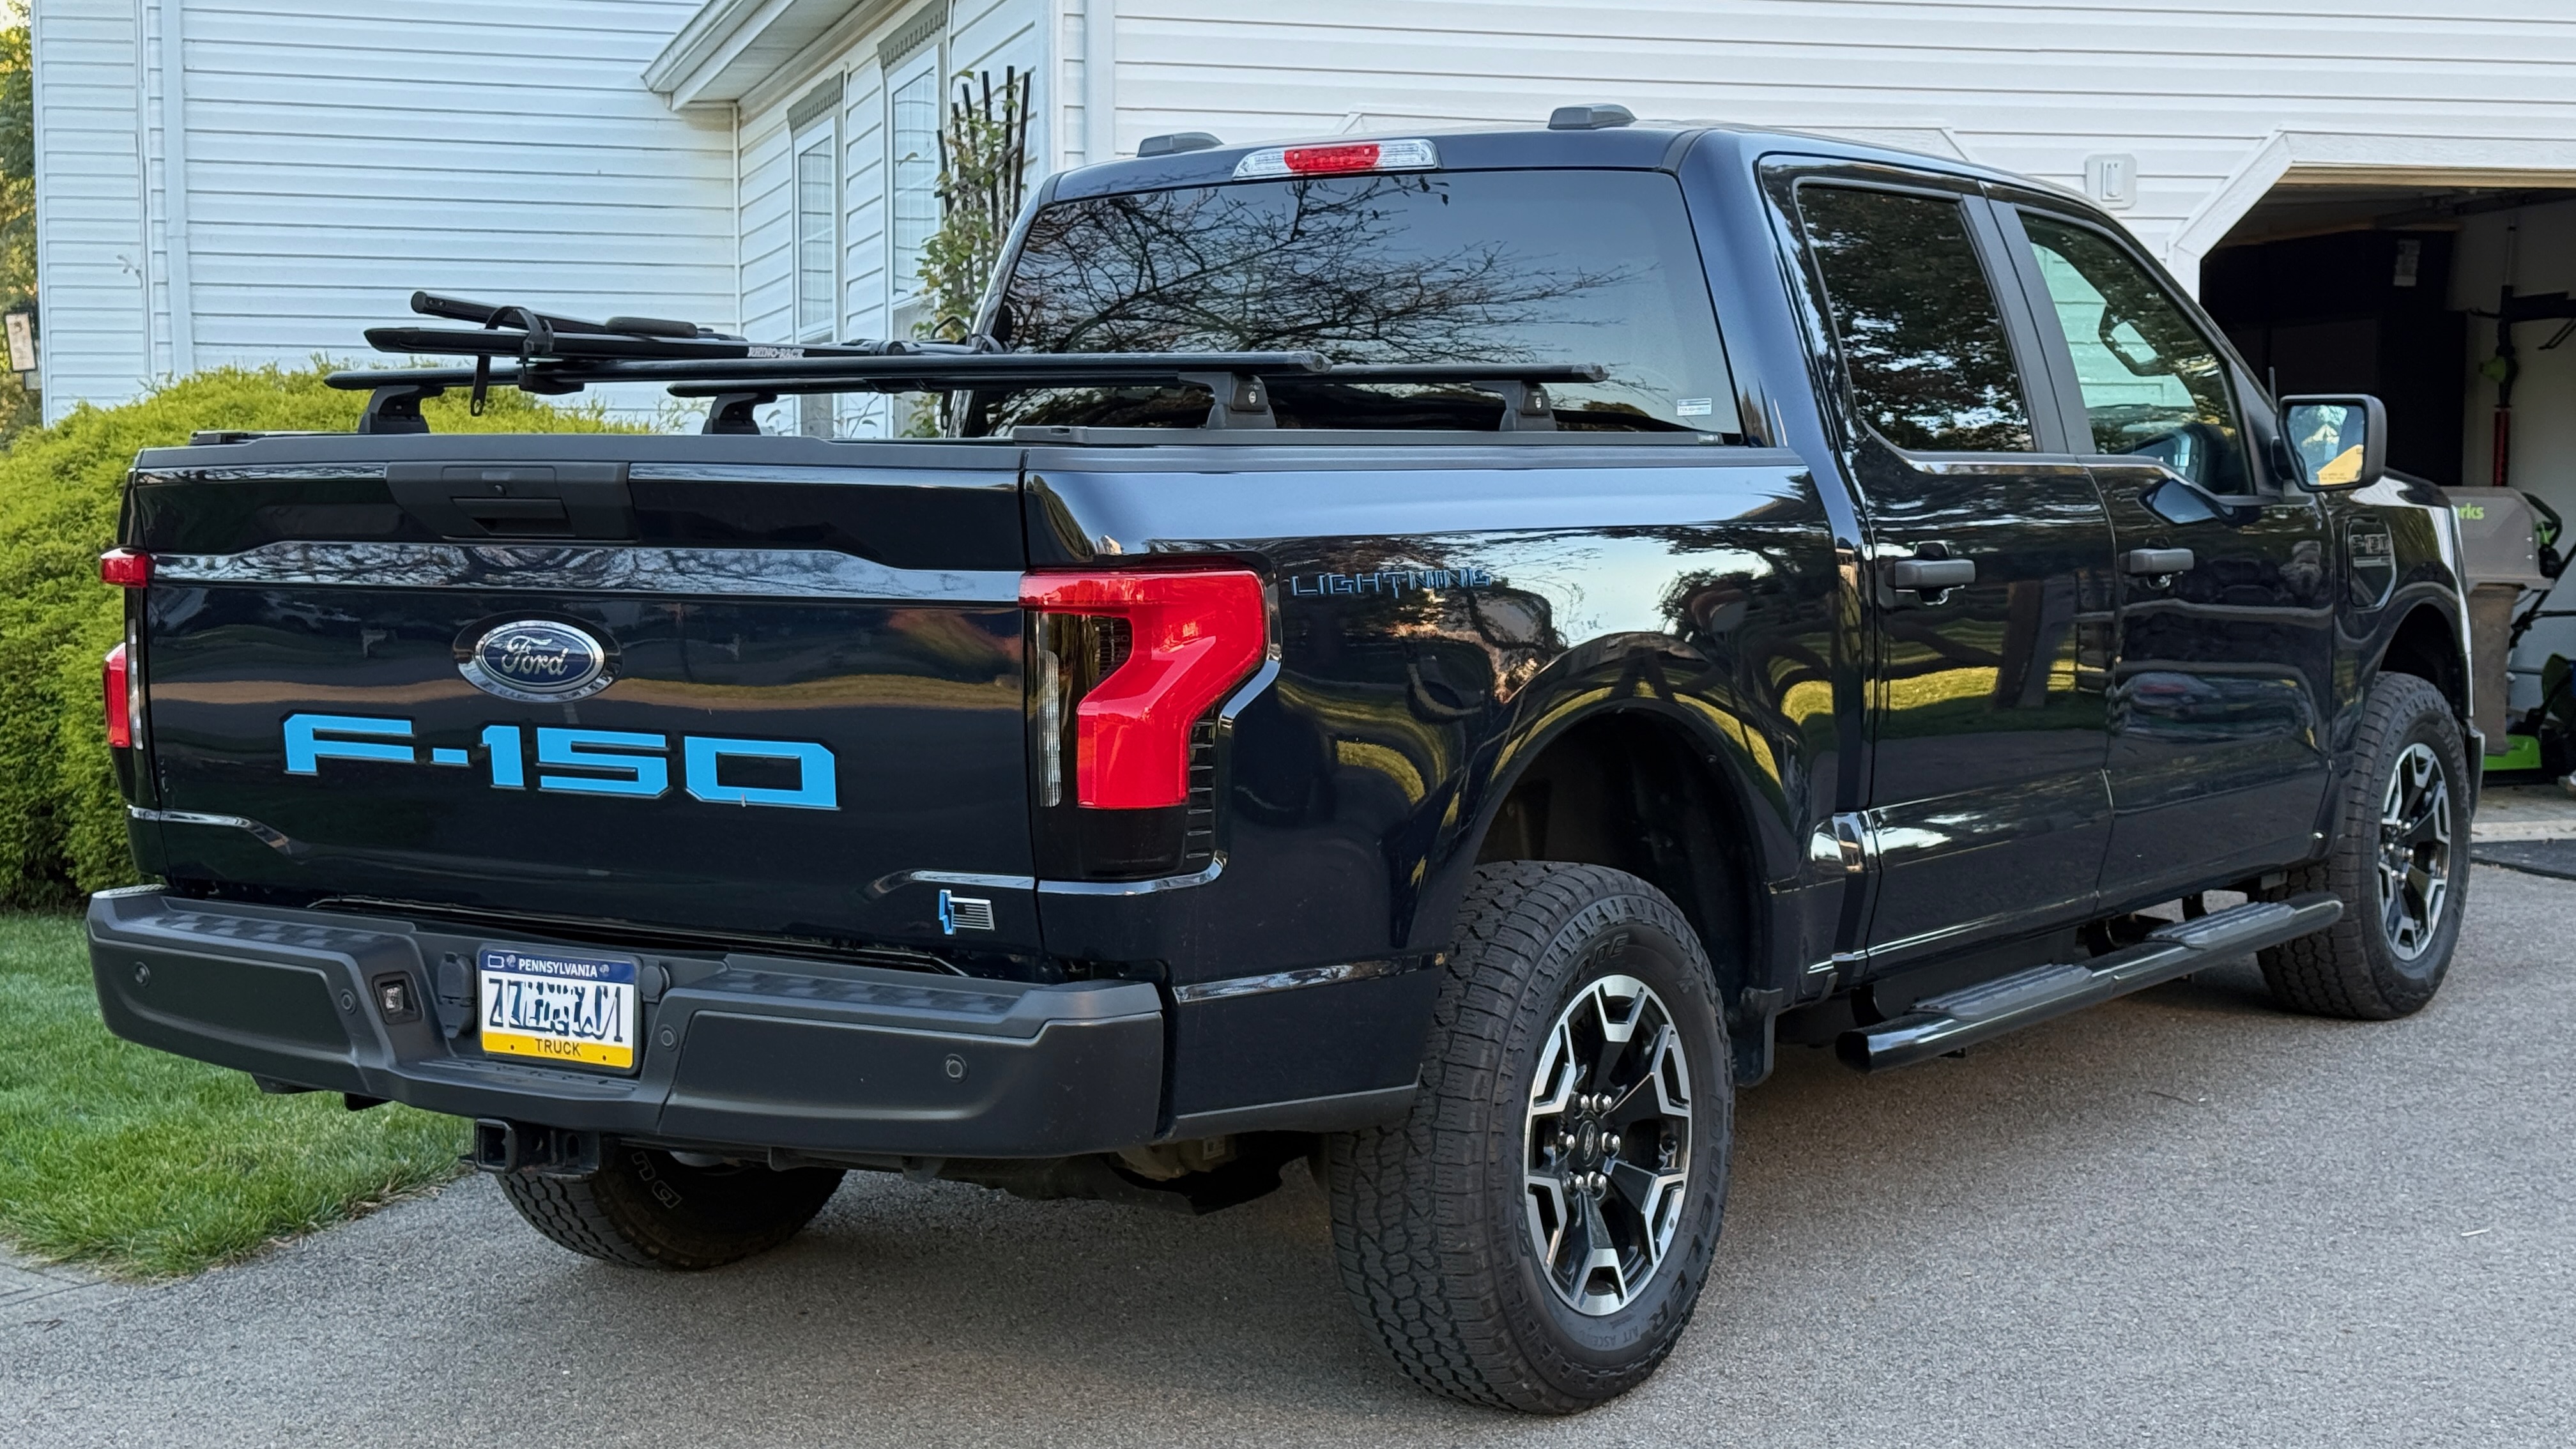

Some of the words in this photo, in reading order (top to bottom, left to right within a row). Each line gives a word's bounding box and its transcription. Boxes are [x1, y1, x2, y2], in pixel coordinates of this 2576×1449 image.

[1291, 568, 1491, 599] LIGHTNING
[502, 636, 569, 675] Ford
[283, 712, 841, 810] F-150
[518, 958, 598, 978] PENNSYLVANIA
[535, 1038, 581, 1057] TRUCK
